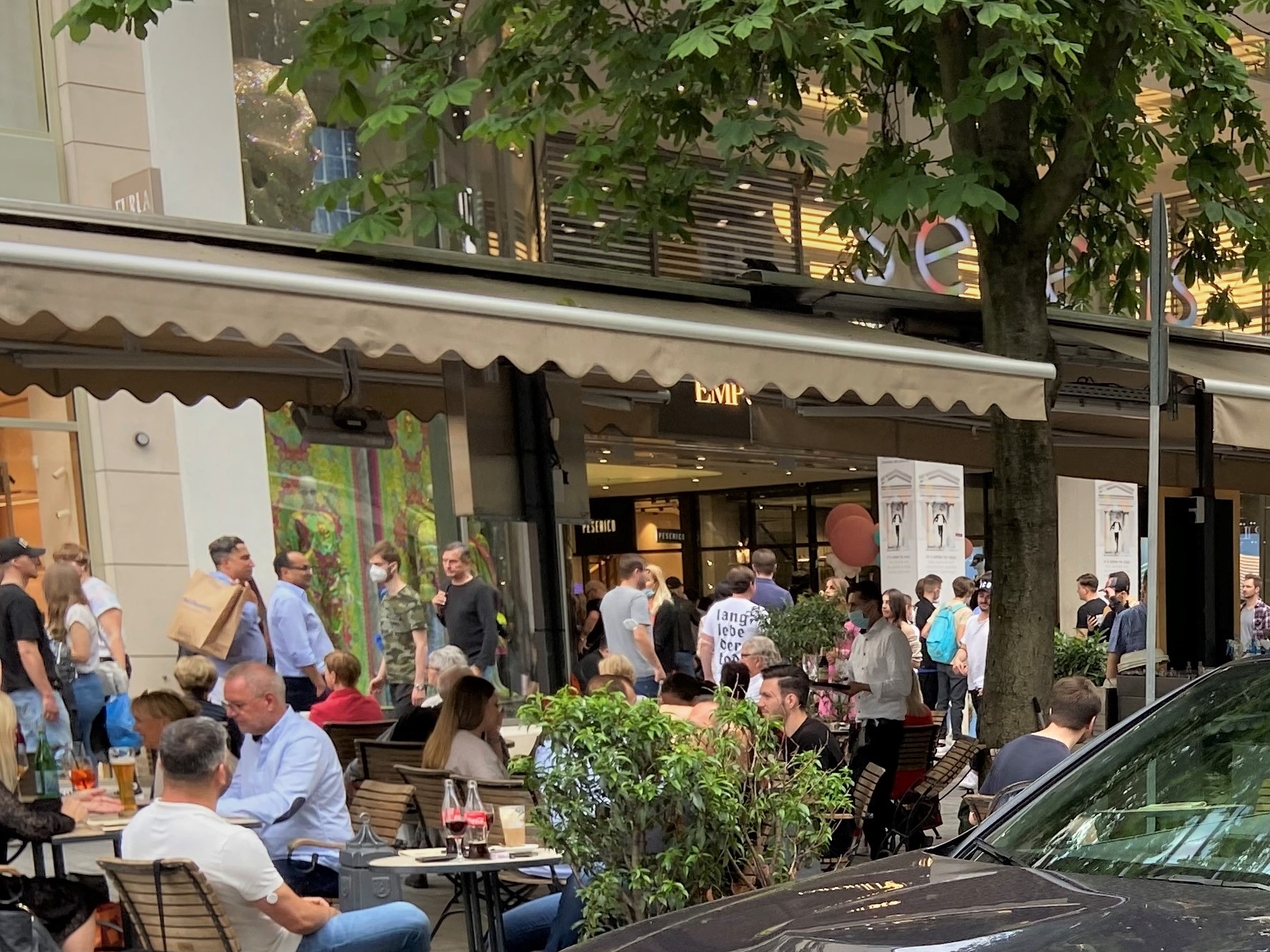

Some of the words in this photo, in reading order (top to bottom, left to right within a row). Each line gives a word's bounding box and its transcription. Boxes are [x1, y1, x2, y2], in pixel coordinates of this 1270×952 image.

[717, 608, 749, 627] lang
[718, 623, 746, 638] lebe
[720, 638, 742, 652] der
